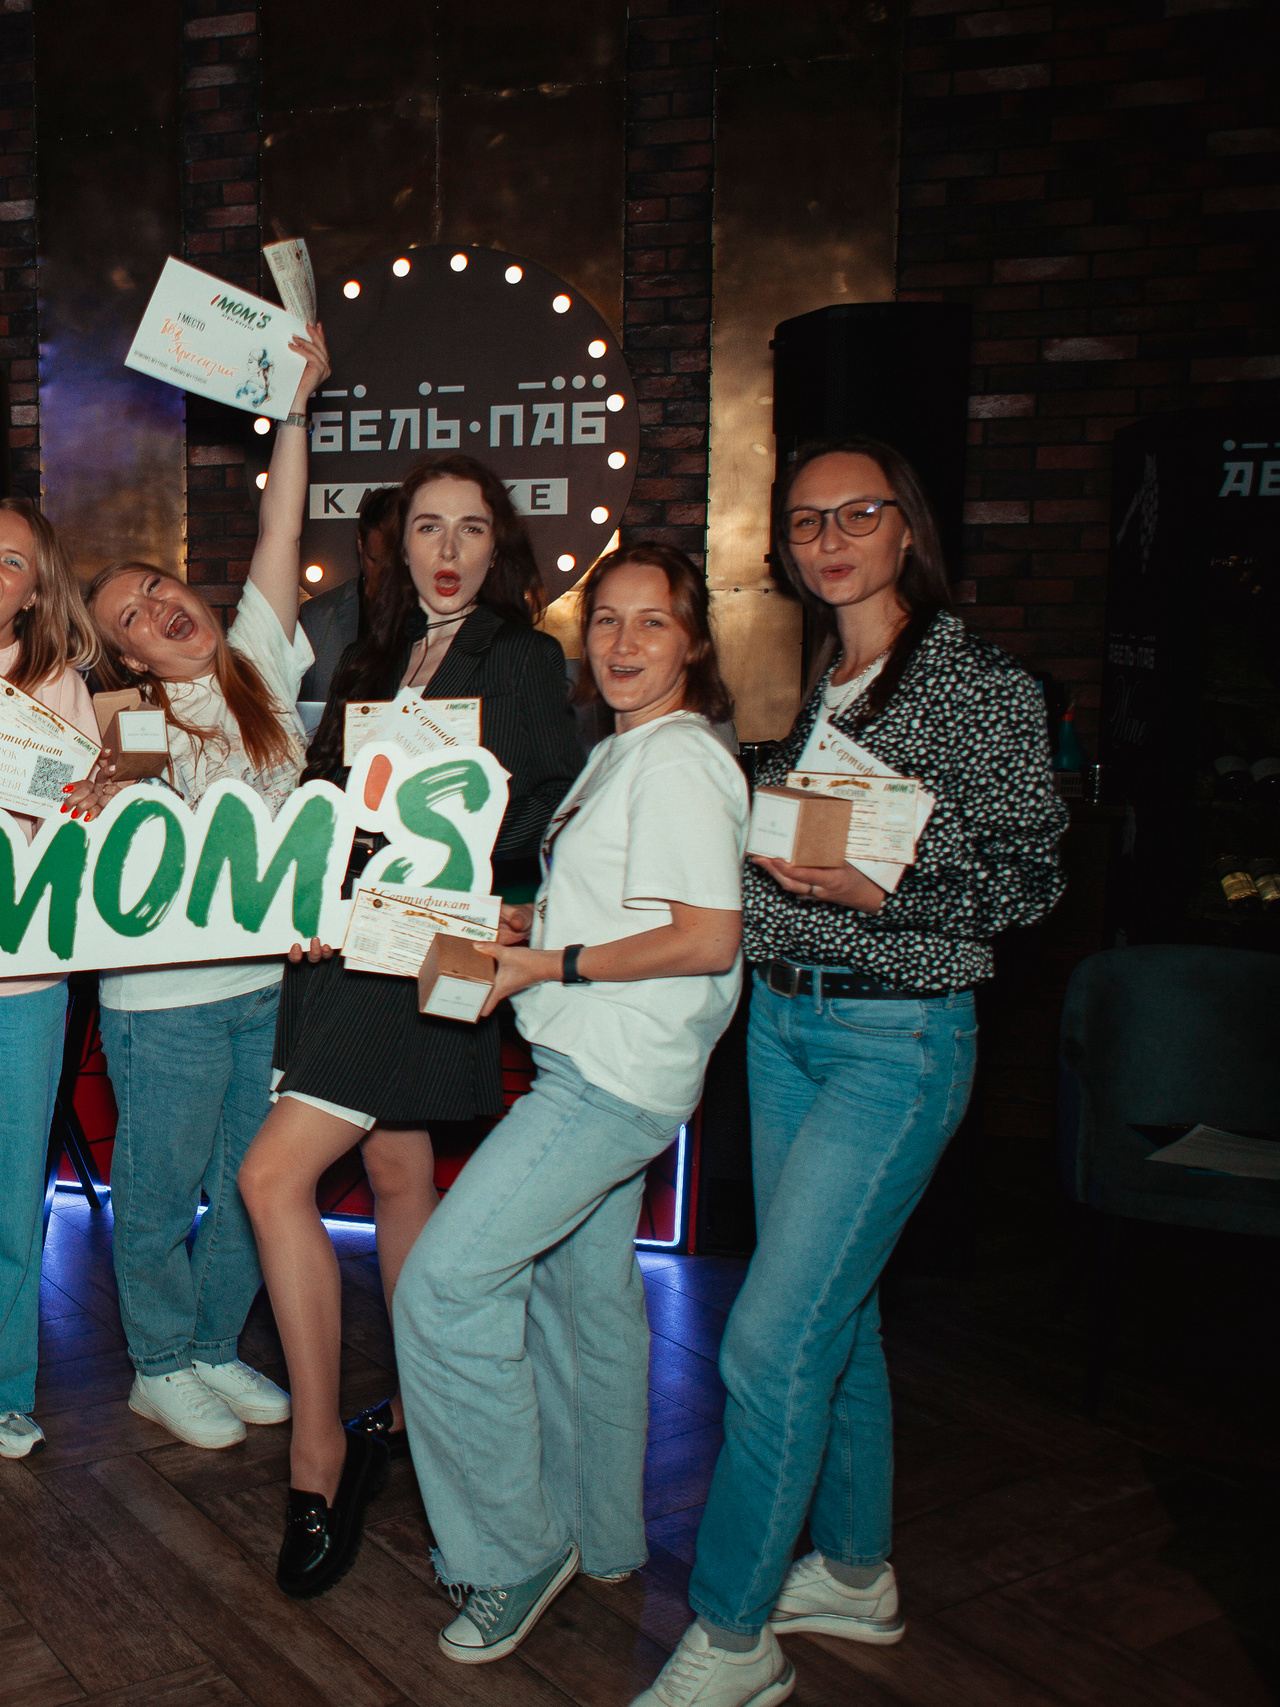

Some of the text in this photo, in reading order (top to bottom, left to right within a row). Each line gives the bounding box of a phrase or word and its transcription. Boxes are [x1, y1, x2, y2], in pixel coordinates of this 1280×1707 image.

[183, 313, 206, 332] МЕСТО
[30, 711, 60, 734] VOUCHER
[414, 708, 459, 747] Сертиф
[830, 740, 878, 777] Сертиф
